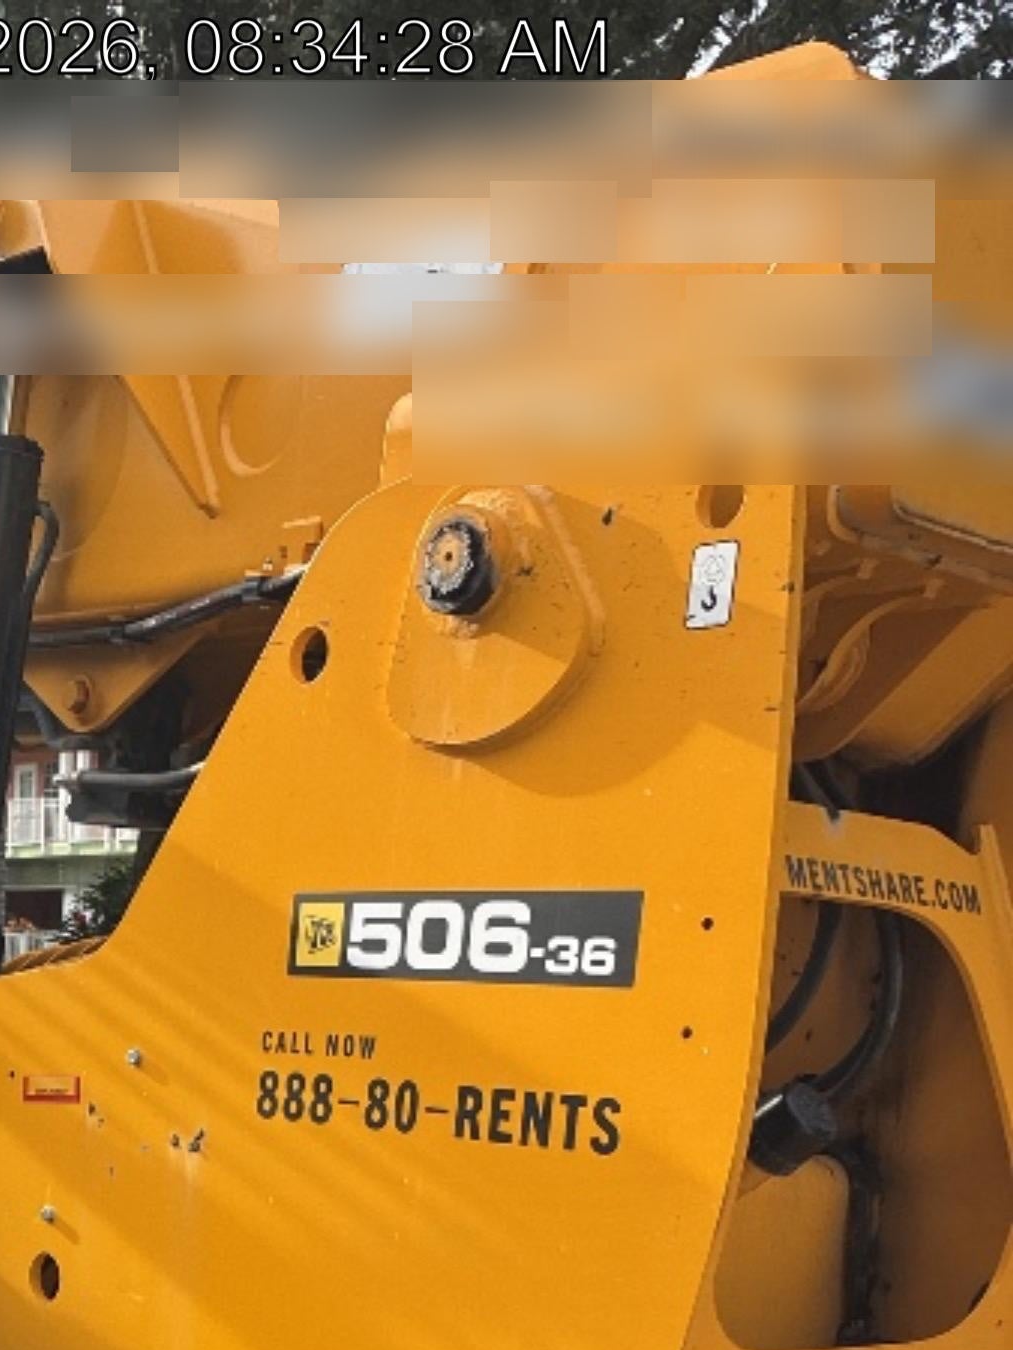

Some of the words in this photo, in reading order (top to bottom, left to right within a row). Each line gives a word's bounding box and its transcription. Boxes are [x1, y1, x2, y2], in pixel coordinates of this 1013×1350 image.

[261, 1031, 314, 1056] CALL
[325, 1033, 377, 1060] NOW
[256, 1070, 622, 1156] 888-80-RENTS
